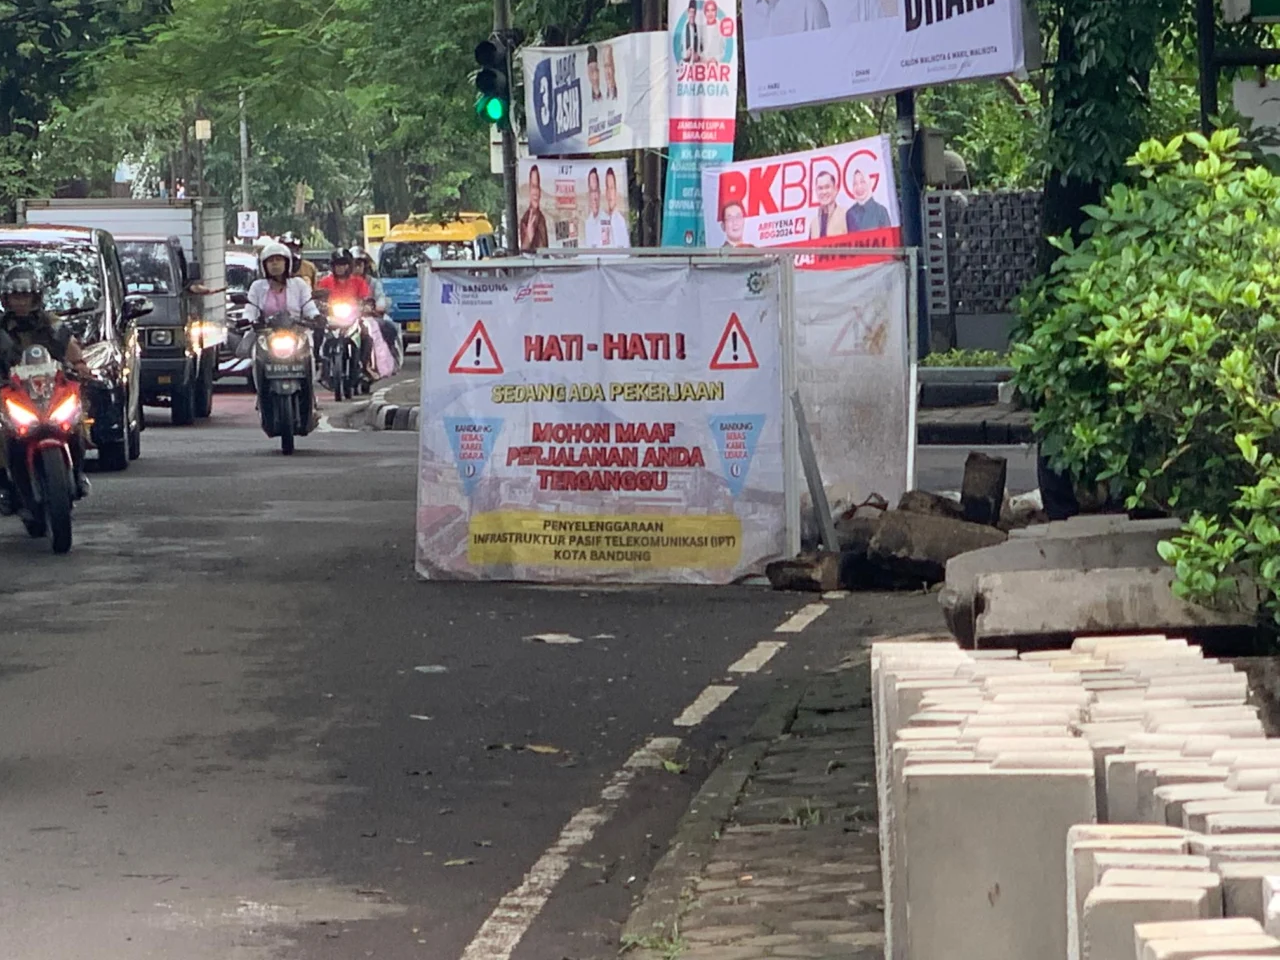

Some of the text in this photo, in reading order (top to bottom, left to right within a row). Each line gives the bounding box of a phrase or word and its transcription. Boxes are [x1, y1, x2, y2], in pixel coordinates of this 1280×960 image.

[677, 63, 731, 82] JABAR
[677, 83, 730, 97] BAHAGIA
[539, 76, 551, 126] 3
[759, 229, 793, 241] BDG2024
[462, 283, 508, 293] BANDUNG
[524, 334, 583, 362] HATI
[603, 332, 670, 360] HATI
[491, 381, 724, 403] SEDANG ADA PEKERJAAN
[455, 424, 493, 433] BANDUNG
[532, 423, 675, 444] MOHON MAAF
[719, 423, 754, 431] BANDUNG
[461, 443, 483, 451] KABEL
[506, 446, 705, 467] PERJALANAN ANDA
[536, 469, 669, 491] TERGANGGU
[543, 520, 663, 532] PENYELENGGARAAN
[474, 533, 736, 548] INFRASTRUKTUR PASIF TELEKOMUNIKASI (IPT)
[554, 549, 651, 562] KOTA BANDUNG
